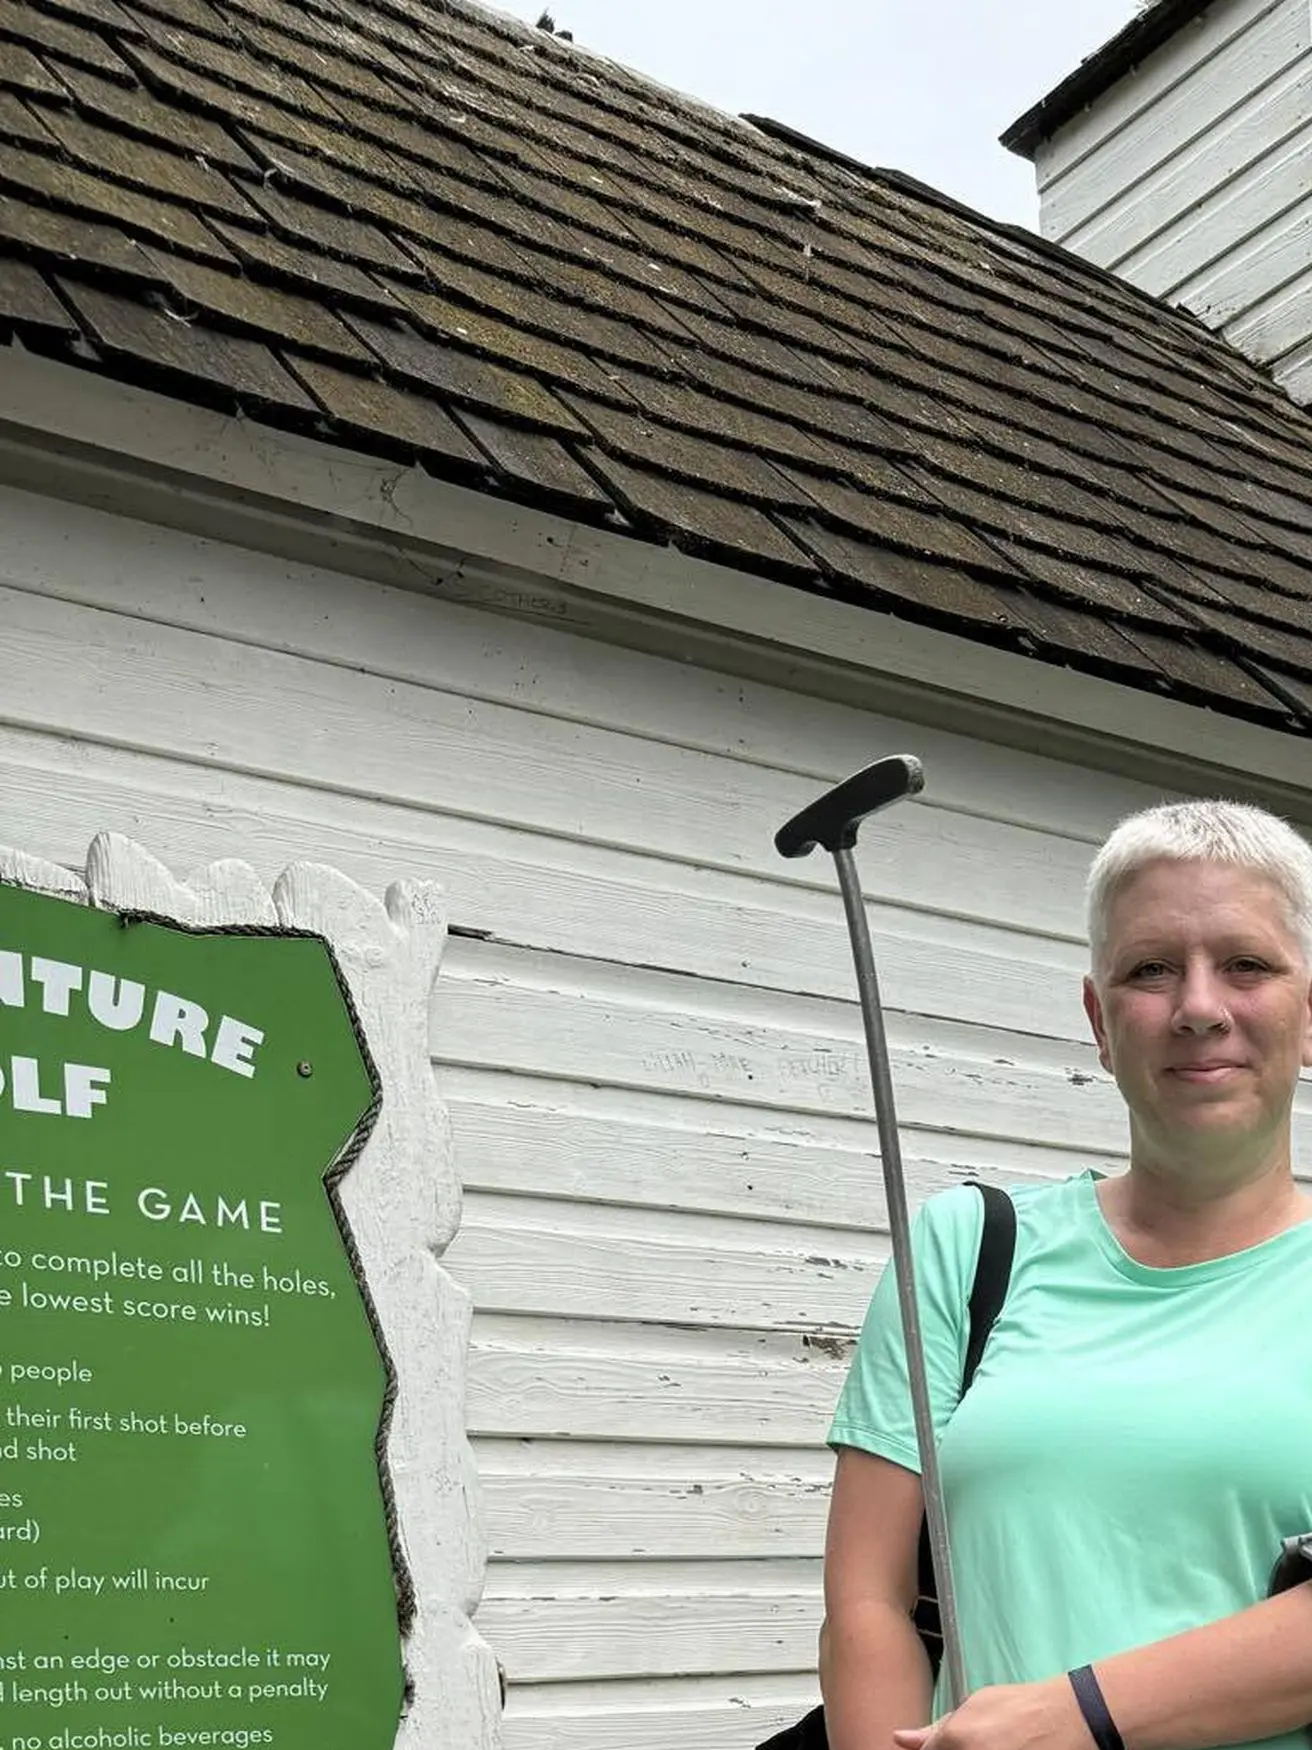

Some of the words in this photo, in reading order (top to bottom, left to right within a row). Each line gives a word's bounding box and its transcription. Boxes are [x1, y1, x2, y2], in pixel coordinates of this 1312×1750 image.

[0, 1055, 112, 1119] LF
[4, 1171, 110, 1214] THE
[137, 1187, 283, 1234] GAME
[0, 1249, 22, 1267] o
[31, 1251, 163, 1281] complete
[172, 1259, 203, 1284] all
[211, 1262, 255, 1289] the
[262, 1265, 336, 1300] holes,
[22, 1281, 114, 1314] lowest
[123, 1299, 197, 1321] score
[204, 1302, 270, 1327] wins!
[10, 1359, 93, 1386] people
[6, 1404, 62, 1428] their
[68, 1407, 112, 1431] first
[119, 1410, 169, 1434] shot
[174, 1413, 247, 1438] before
[26, 1438, 77, 1462] shot
[24, 1566, 48, 1589] of
[55, 1567, 105, 1596] play
[111, 1568, 148, 1590] will
[155, 1571, 209, 1591] incur
[33, 1655, 64, 1669] an
[70, 1647, 130, 1674] edge
[136, 1654, 161, 1669] or
[166, 1646, 261, 1668] obstacle
[266, 1648, 281, 1667] it
[286, 1653, 331, 1672] may
[12, 1680, 88, 1708] length
[94, 1681, 133, 1701] out
[138, 1678, 223, 1700] without
[227, 1685, 242, 1698] a
[248, 1676, 329, 1703] penalty
[12, 1736, 42, 1750] no
[48, 1727, 152, 1750] alcoholic
[158, 1725, 273, 1749] beverages
